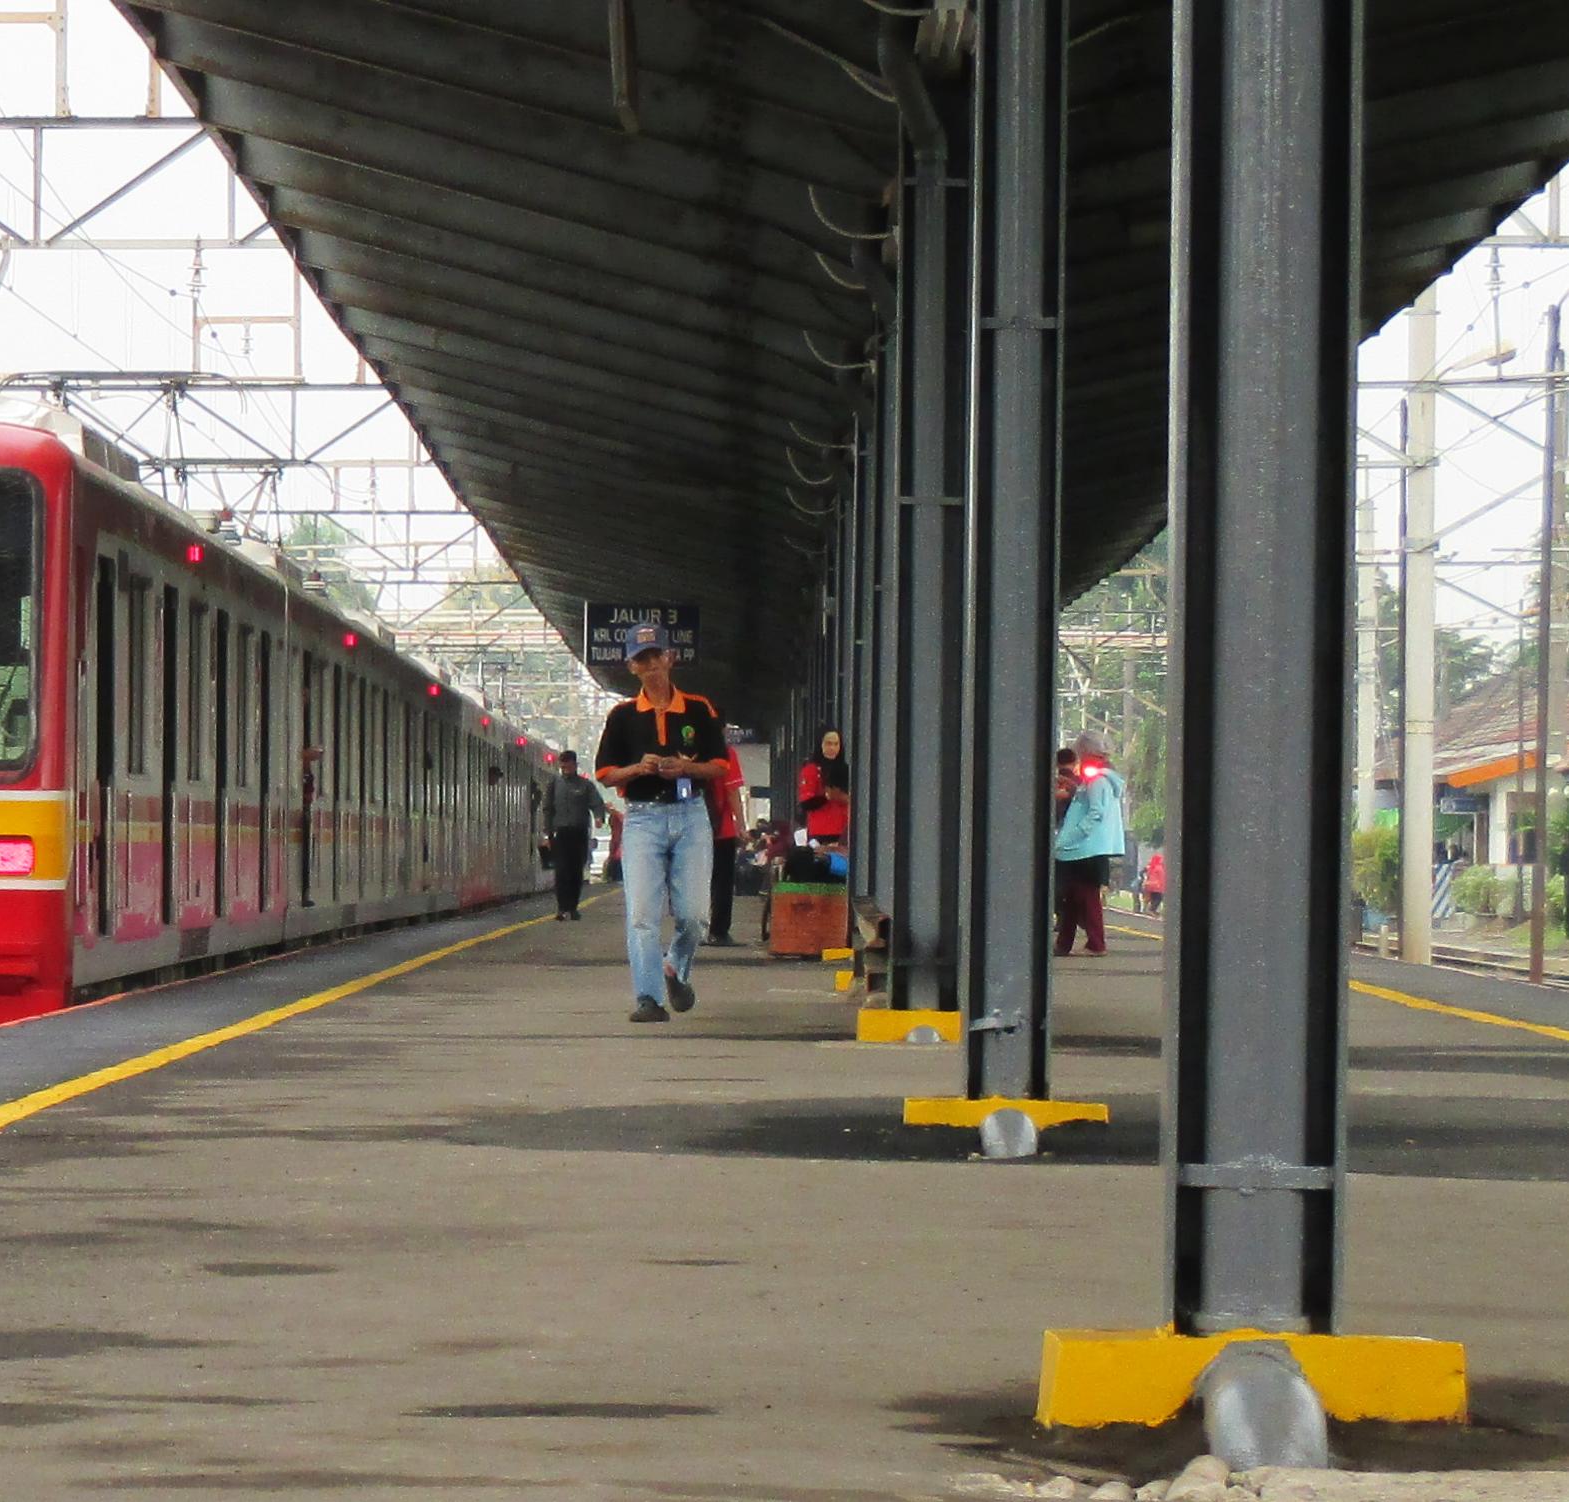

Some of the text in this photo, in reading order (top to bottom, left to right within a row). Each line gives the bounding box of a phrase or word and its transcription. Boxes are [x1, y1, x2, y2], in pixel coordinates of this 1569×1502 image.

[609, 608, 679, 624] JALUR 3
[593, 629, 612, 643] KRL
[672, 630, 694, 643] LINE
